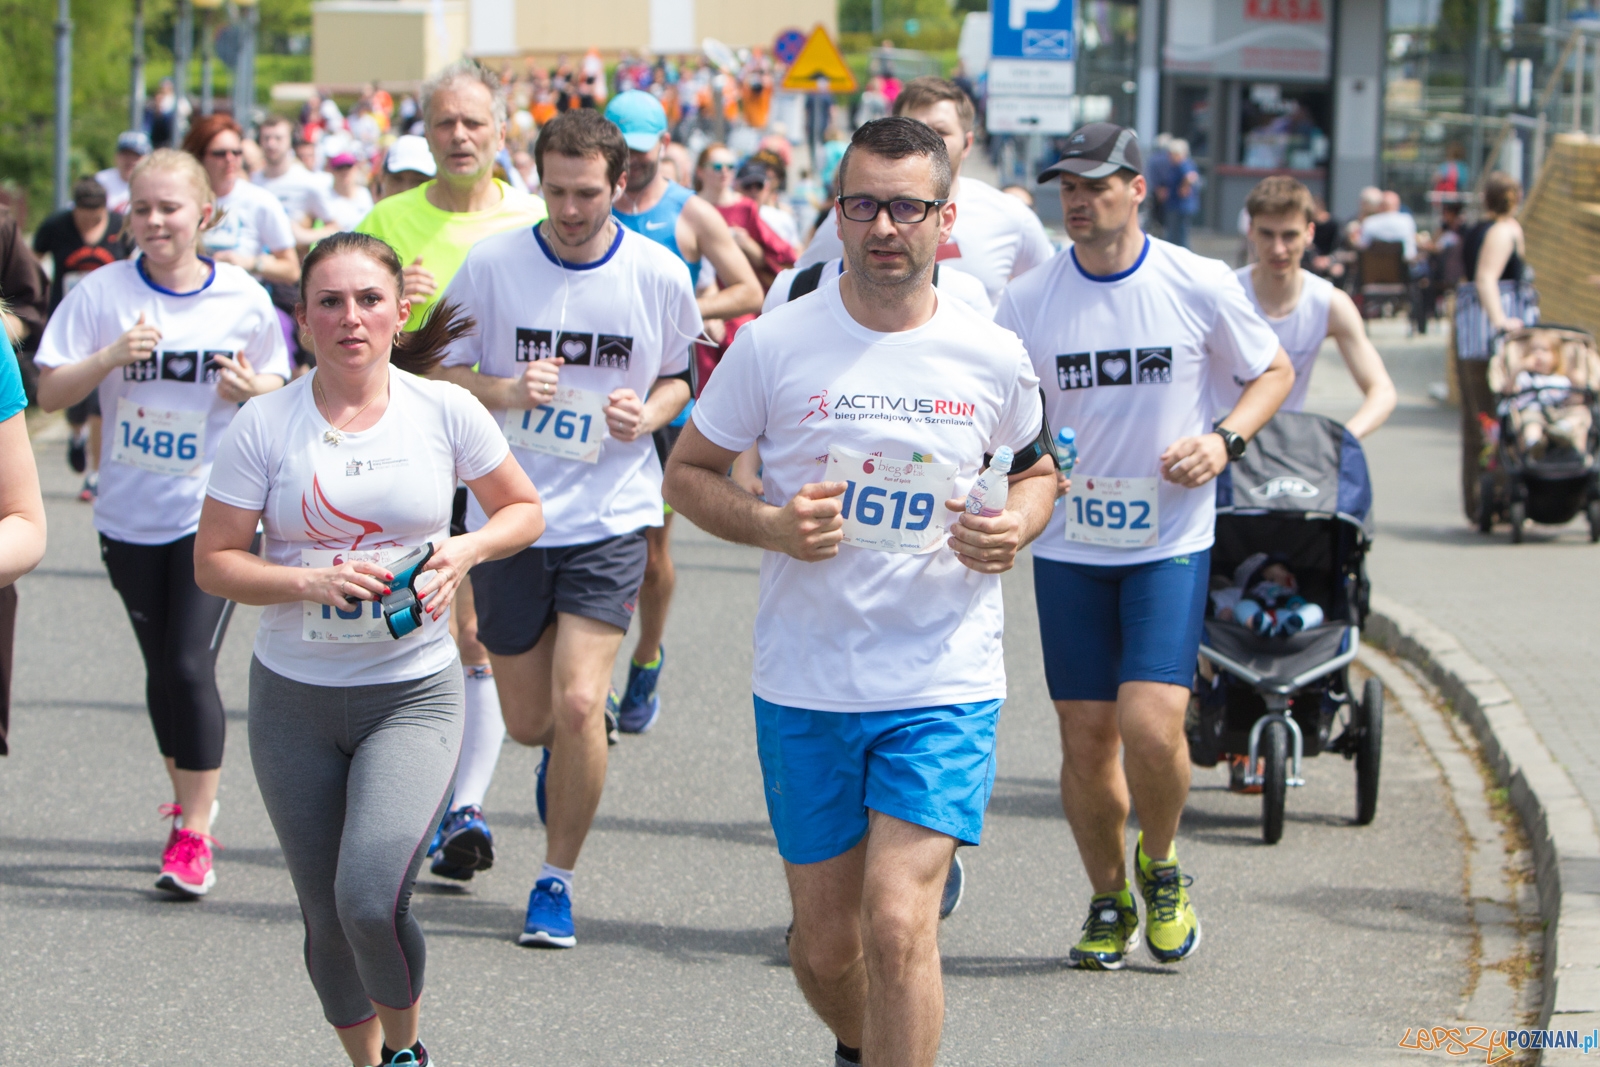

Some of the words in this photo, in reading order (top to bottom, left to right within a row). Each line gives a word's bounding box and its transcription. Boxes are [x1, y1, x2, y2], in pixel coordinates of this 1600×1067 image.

[521, 404, 592, 443] 1761
[834, 412, 856, 421] bieg
[858, 413, 912, 424] przełajowy
[121, 421, 197, 460] 1486
[878, 460, 902, 477] bieg
[841, 479, 935, 531] 1619
[1072, 496, 1150, 530] 1692
